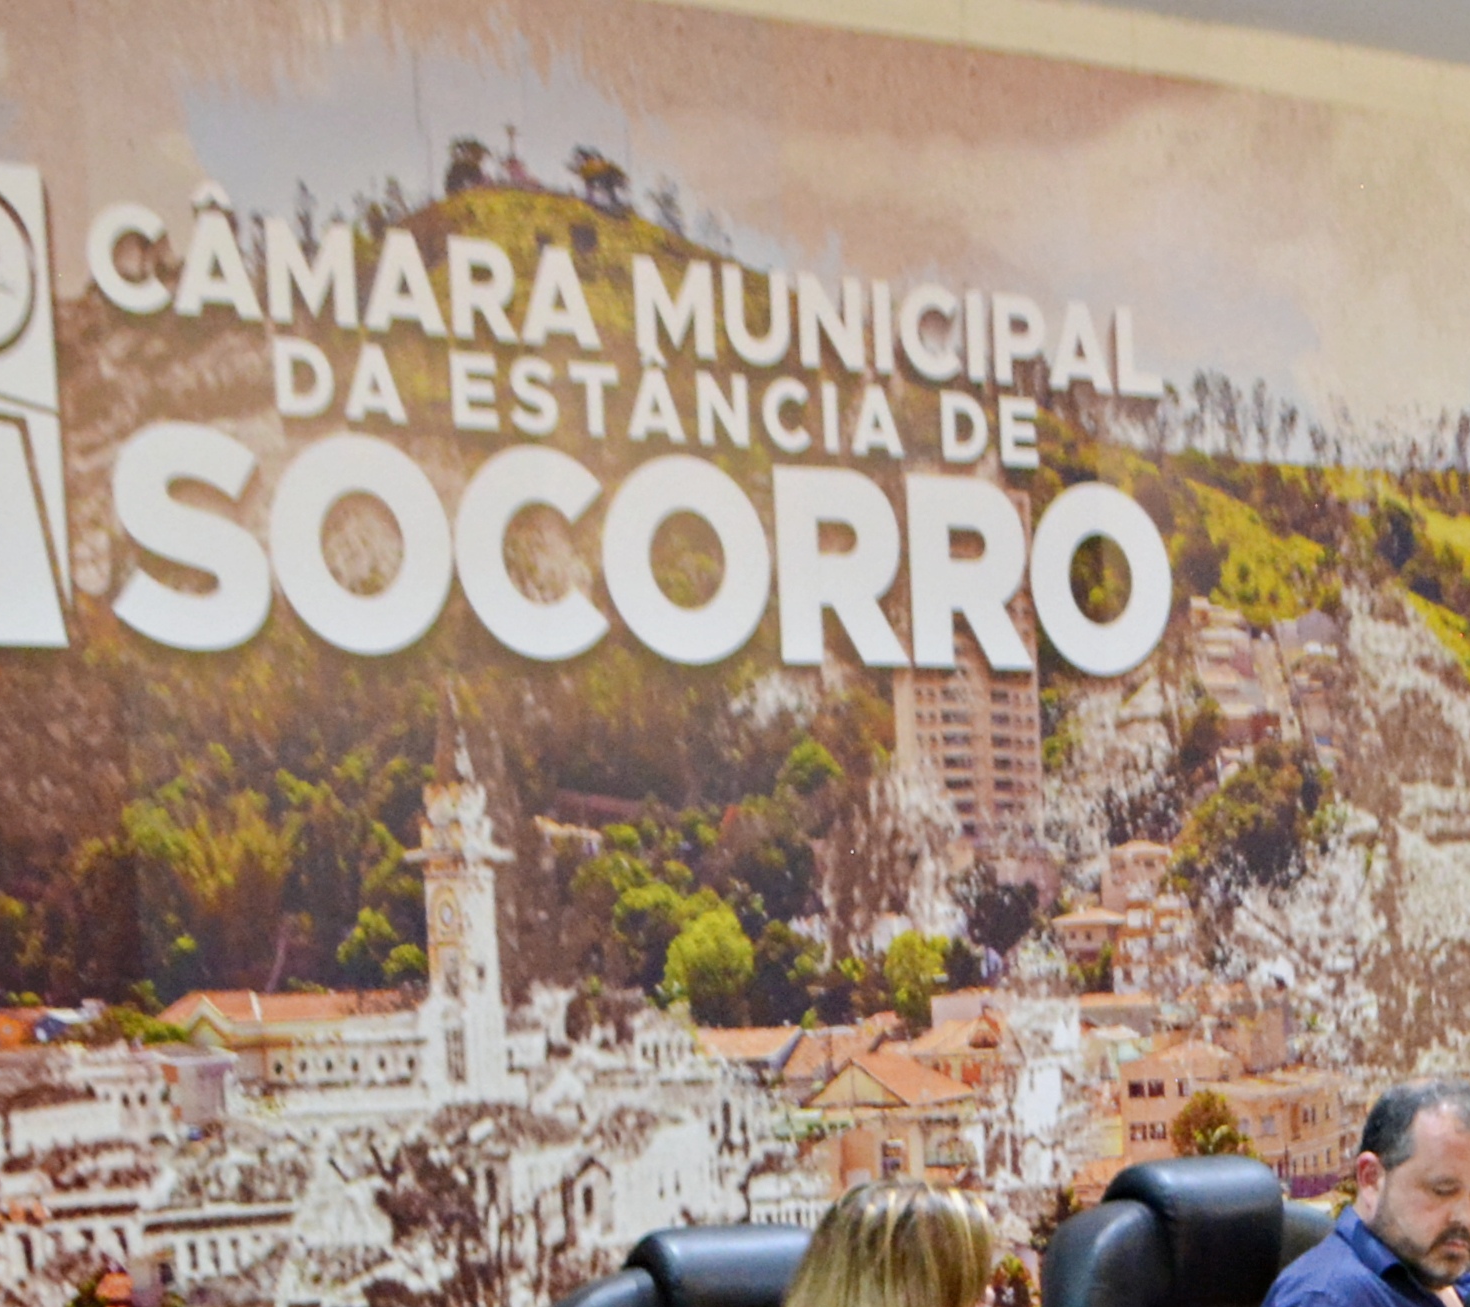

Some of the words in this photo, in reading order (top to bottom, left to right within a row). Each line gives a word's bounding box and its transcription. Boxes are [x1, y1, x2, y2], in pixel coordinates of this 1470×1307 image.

[85, 180, 598, 346] CÂMARA
[634, 259, 1165, 395] MUNICIPAL
[273, 339, 405, 421] DA
[451, 345, 902, 454] ESTÂNCIA
[941, 393, 1038, 464] DE
[112, 422, 1172, 675] SOCORRO
